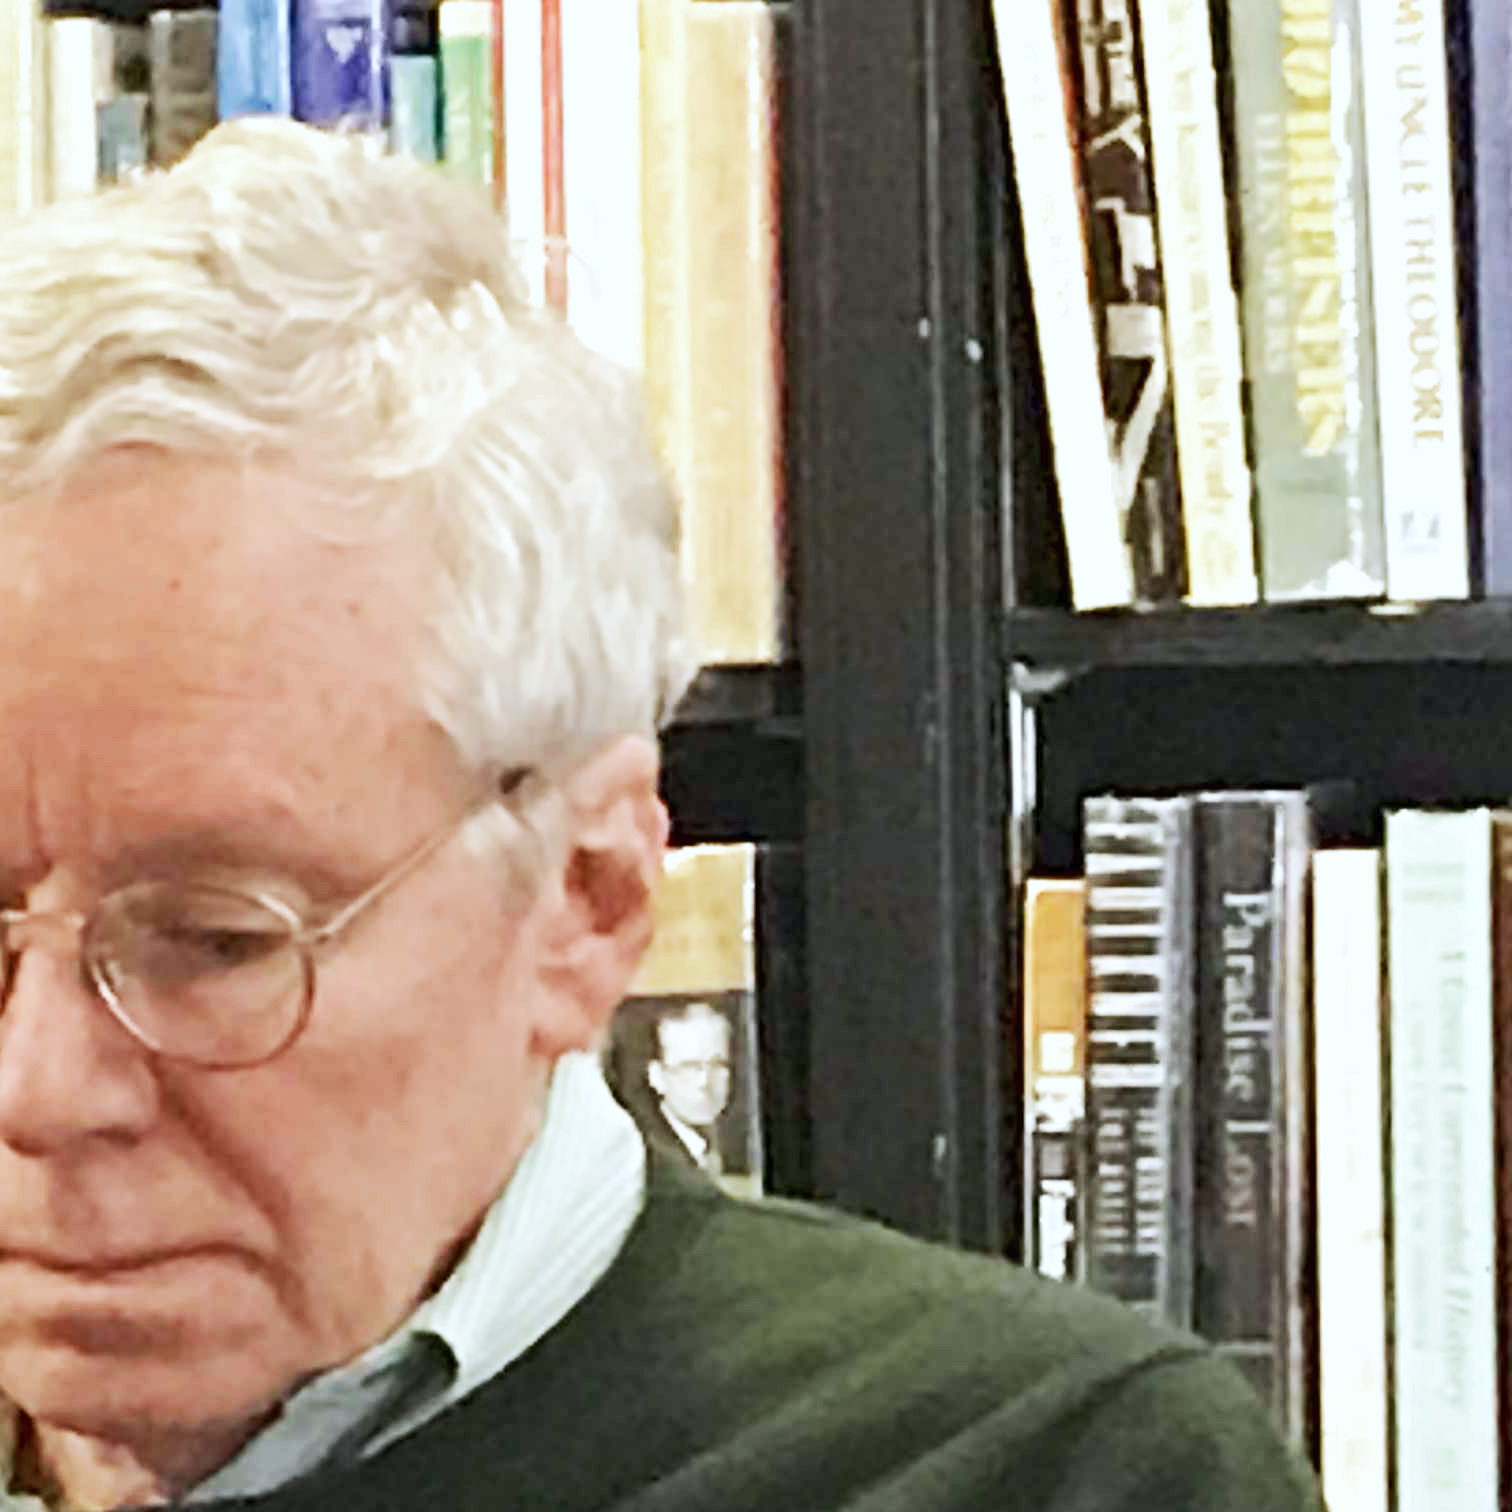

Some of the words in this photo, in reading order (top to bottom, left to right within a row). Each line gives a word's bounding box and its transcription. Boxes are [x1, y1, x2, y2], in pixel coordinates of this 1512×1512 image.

[1396, 63, 1434, 197] UNCLE
[1405, 214, 1445, 447] THEODORE
[1221, 890, 1275, 1101] Paradise
[1222, 1120, 1273, 1228] Lost
